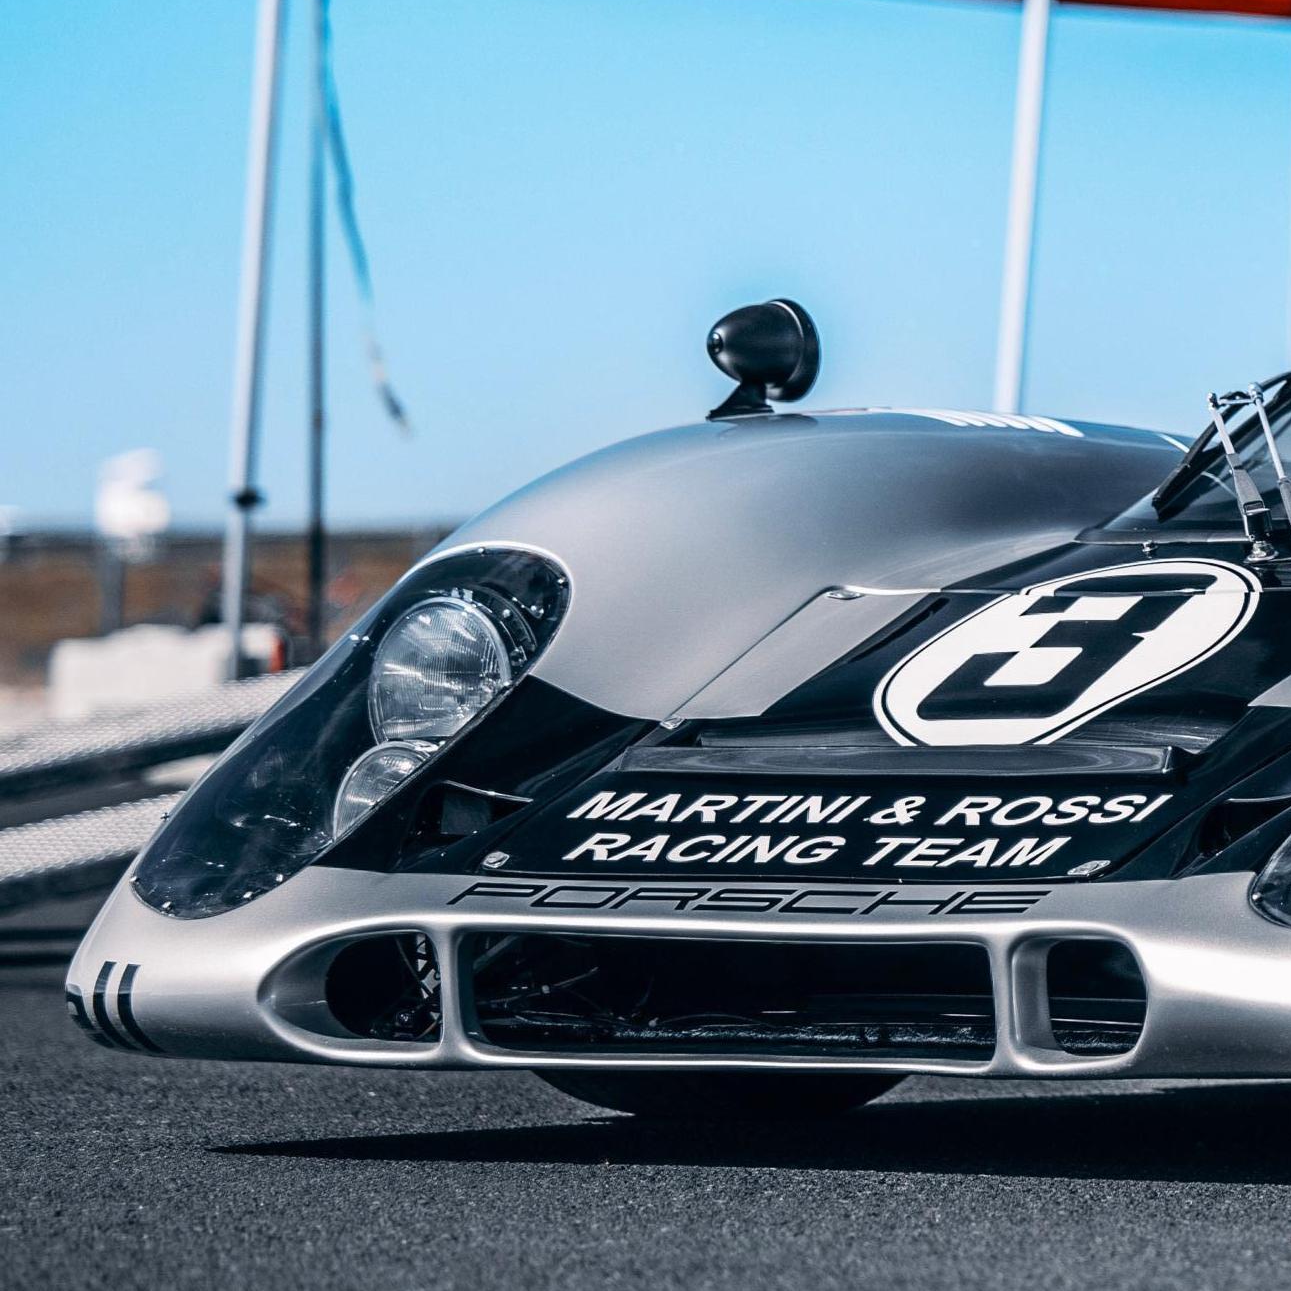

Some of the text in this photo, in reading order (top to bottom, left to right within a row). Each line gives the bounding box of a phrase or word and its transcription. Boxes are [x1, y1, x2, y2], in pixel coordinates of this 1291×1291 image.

[916, 571, 1220, 720] 3
[566, 791, 1174, 826] MARTINI & ROSSI
[562, 832, 1073, 867] RACING TEAM
[446, 882, 1052, 915] PORSCHE
